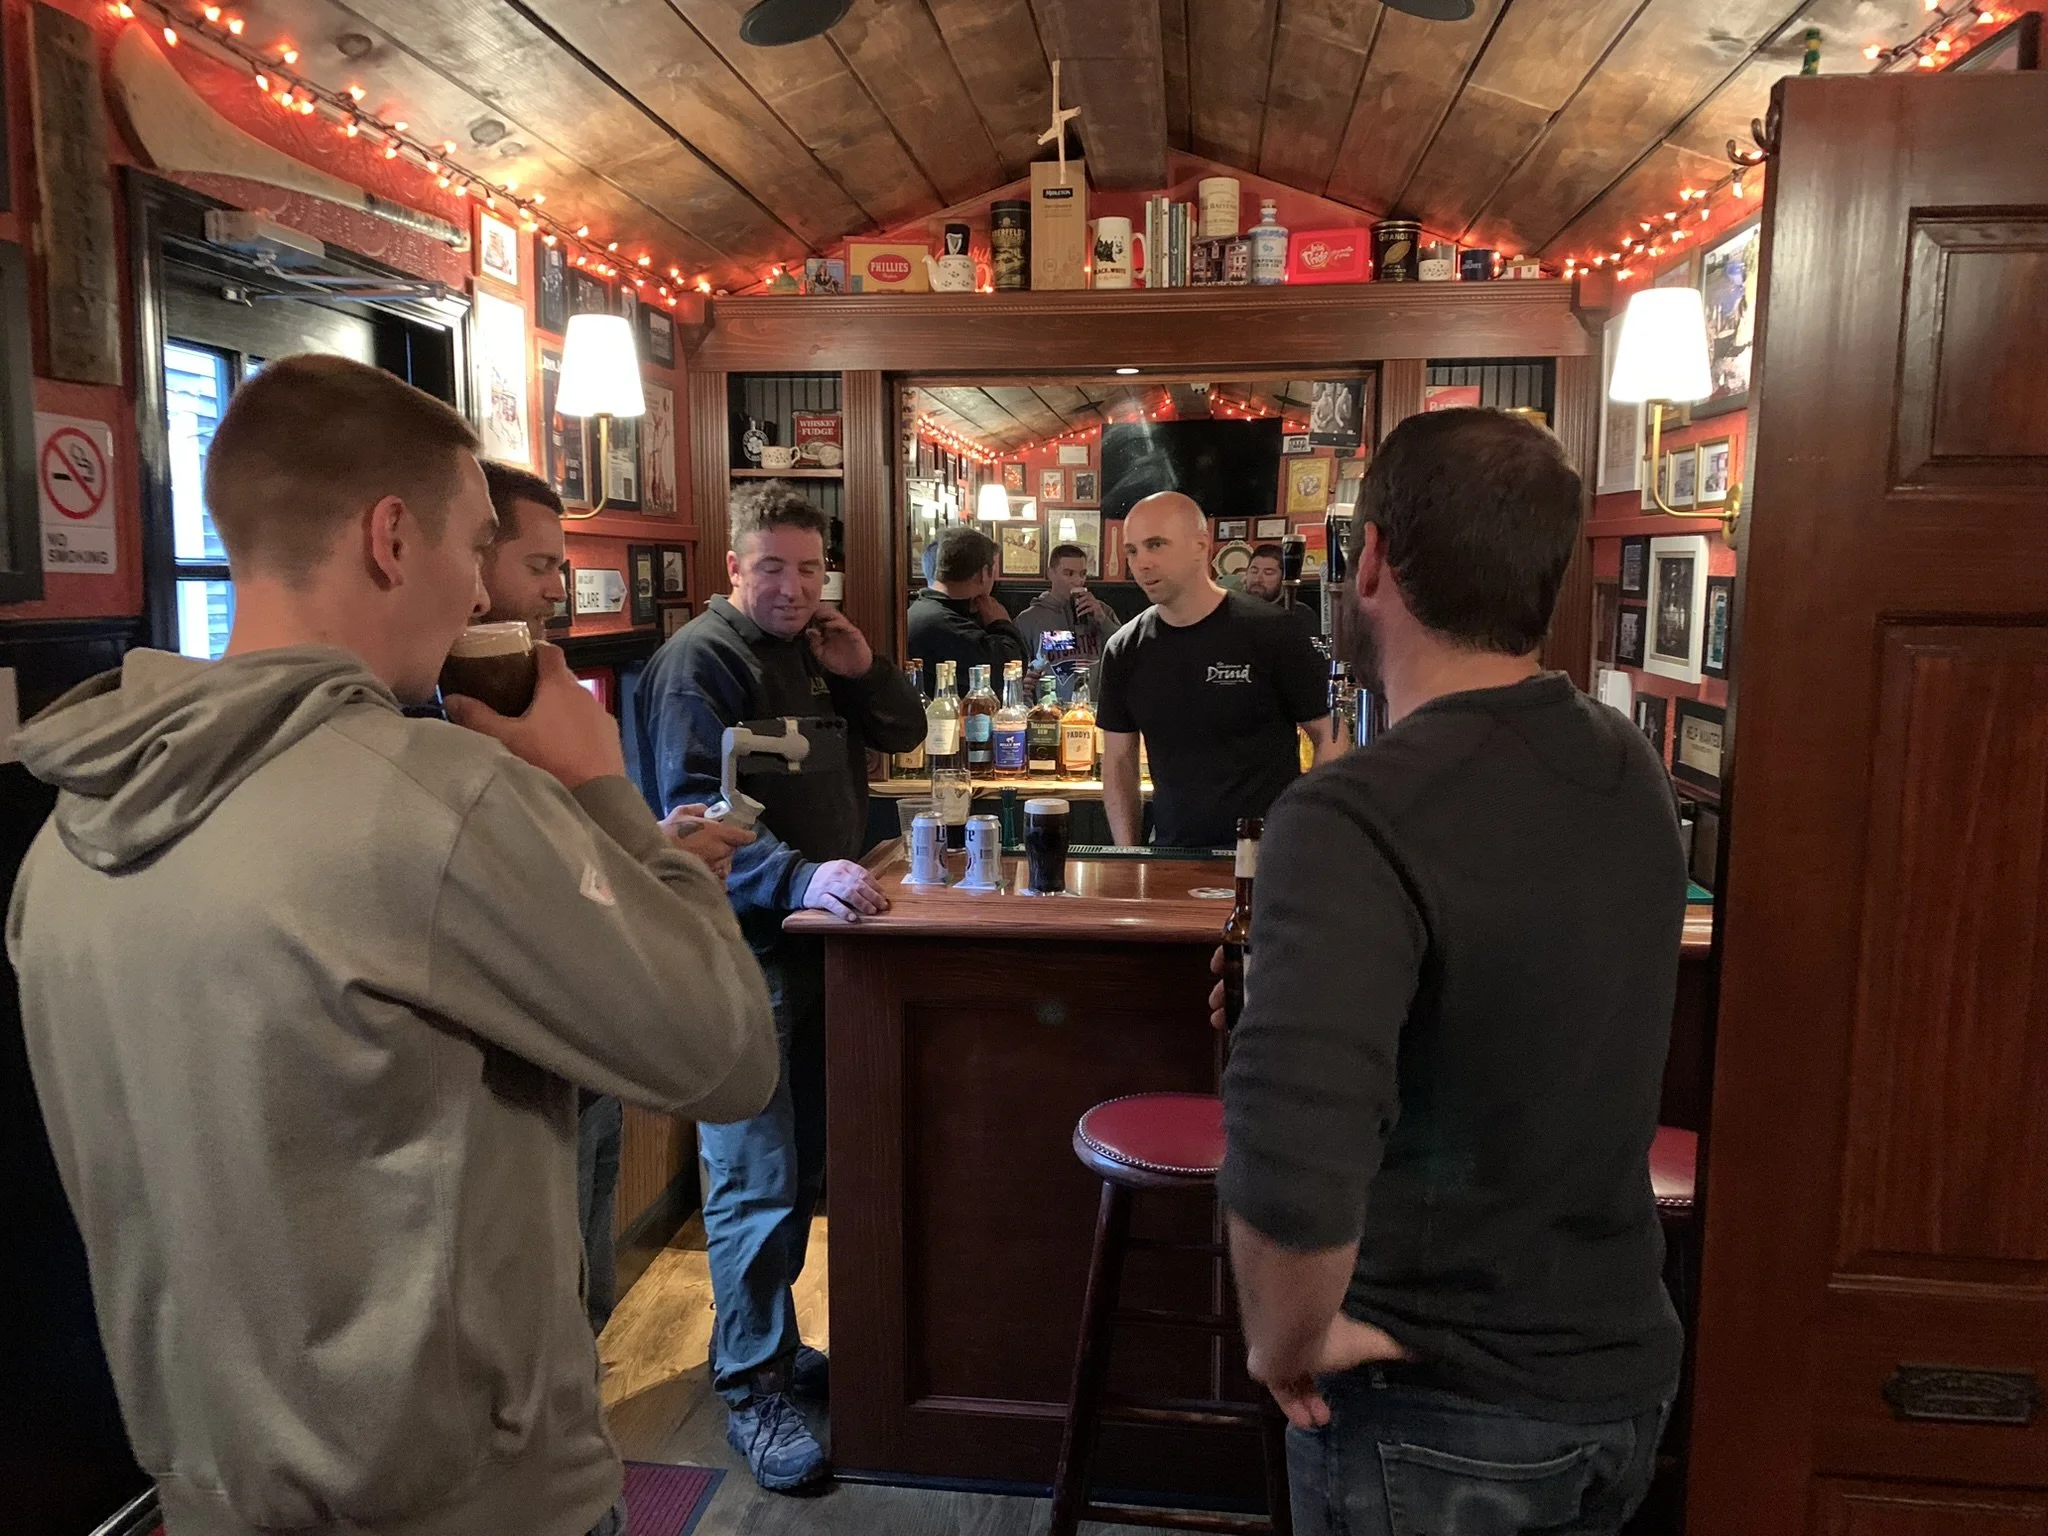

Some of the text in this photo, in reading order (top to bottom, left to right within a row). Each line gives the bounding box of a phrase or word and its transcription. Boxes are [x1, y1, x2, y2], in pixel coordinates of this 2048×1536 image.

[1302, 251, 1329, 266] Pride
[870, 262, 909, 273] PHILLIES
[799, 419, 837, 428] WHISKEY
[802, 427, 834, 436] FUDGE
[46, 532, 68, 548] NO
[48, 549, 109, 565] SMOKING
[1205, 663, 1252, 683] Druid
